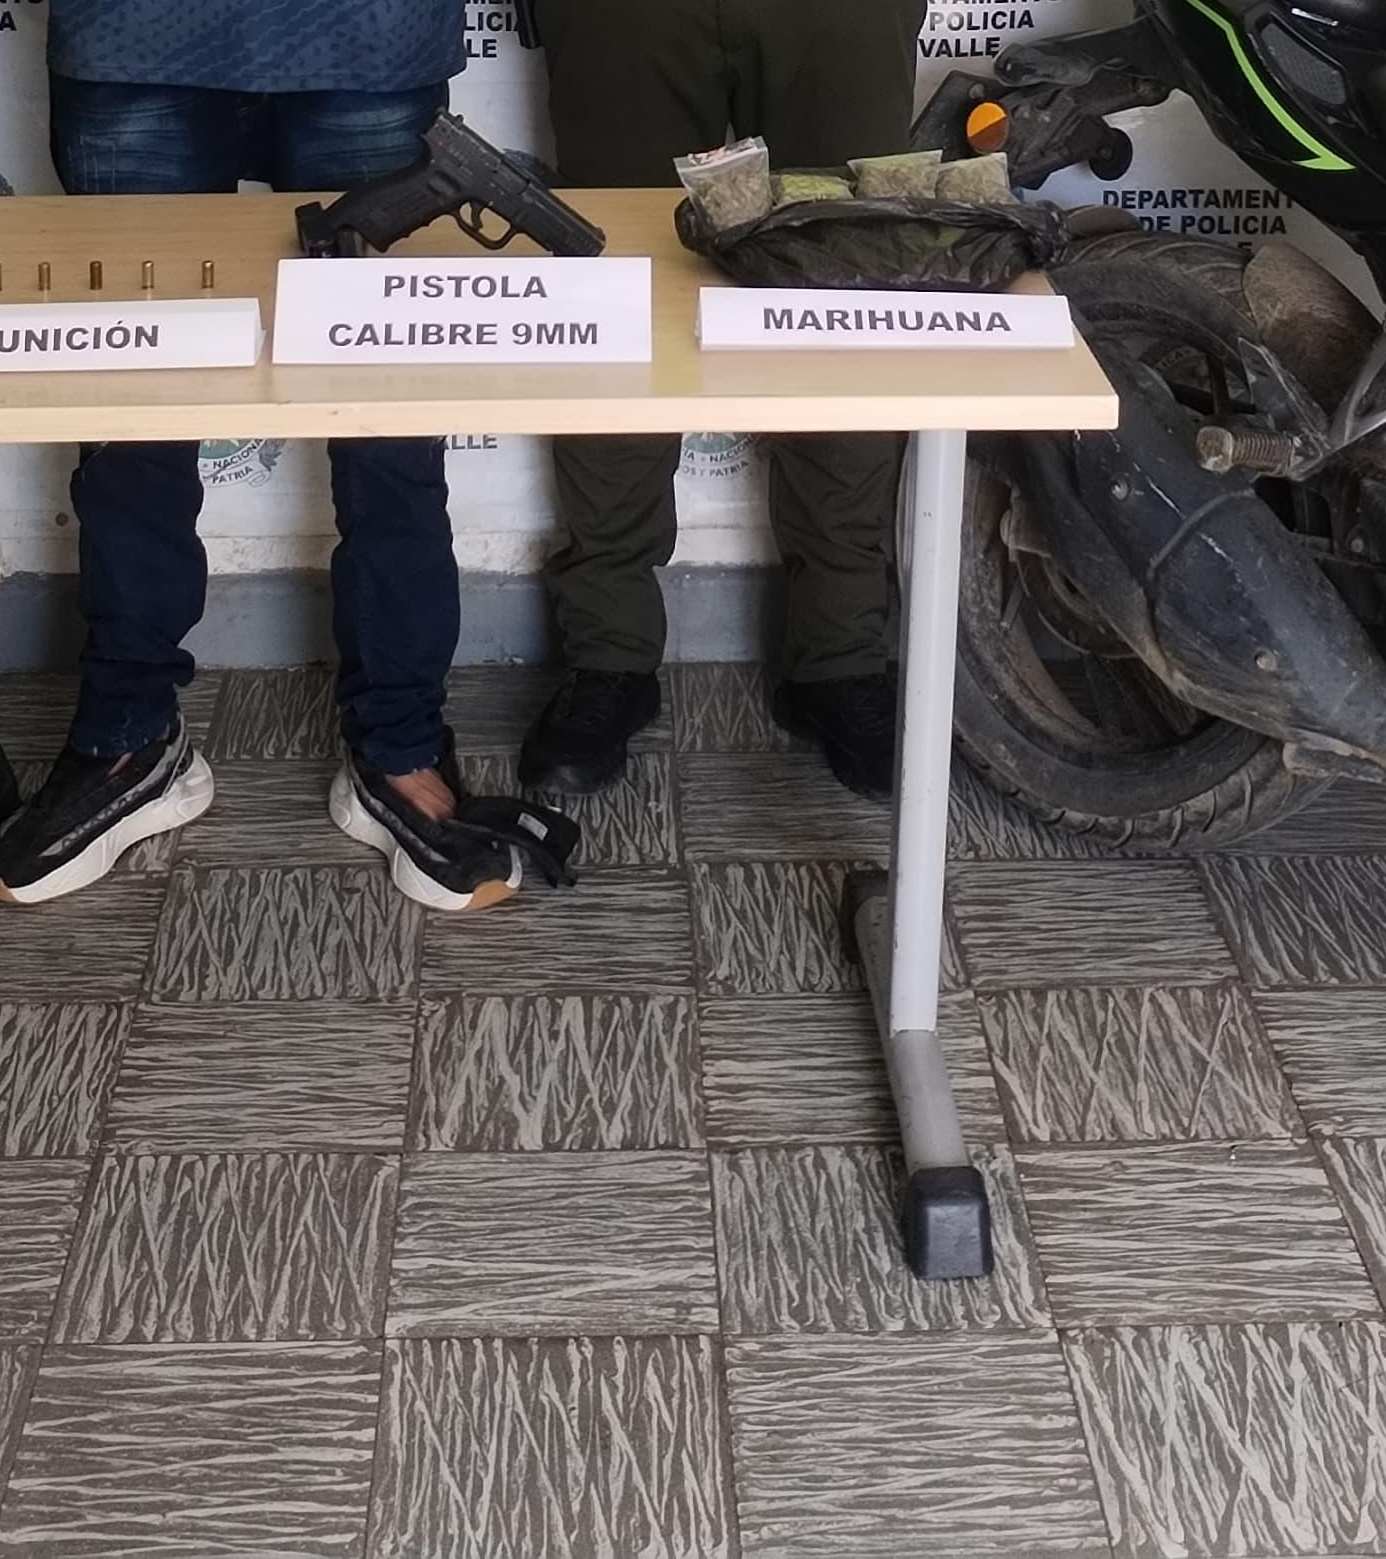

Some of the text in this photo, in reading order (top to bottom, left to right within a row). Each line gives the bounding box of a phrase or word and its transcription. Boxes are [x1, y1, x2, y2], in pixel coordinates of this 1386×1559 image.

[929, 9, 1035, 32] POLICIA
[917, 36, 1001, 59] VALLE
[384, 275, 547, 298] PISTOLA
[763, 308, 1011, 332] MARIHUANA
[328, 323, 598, 347] CALIBRE 9MM
